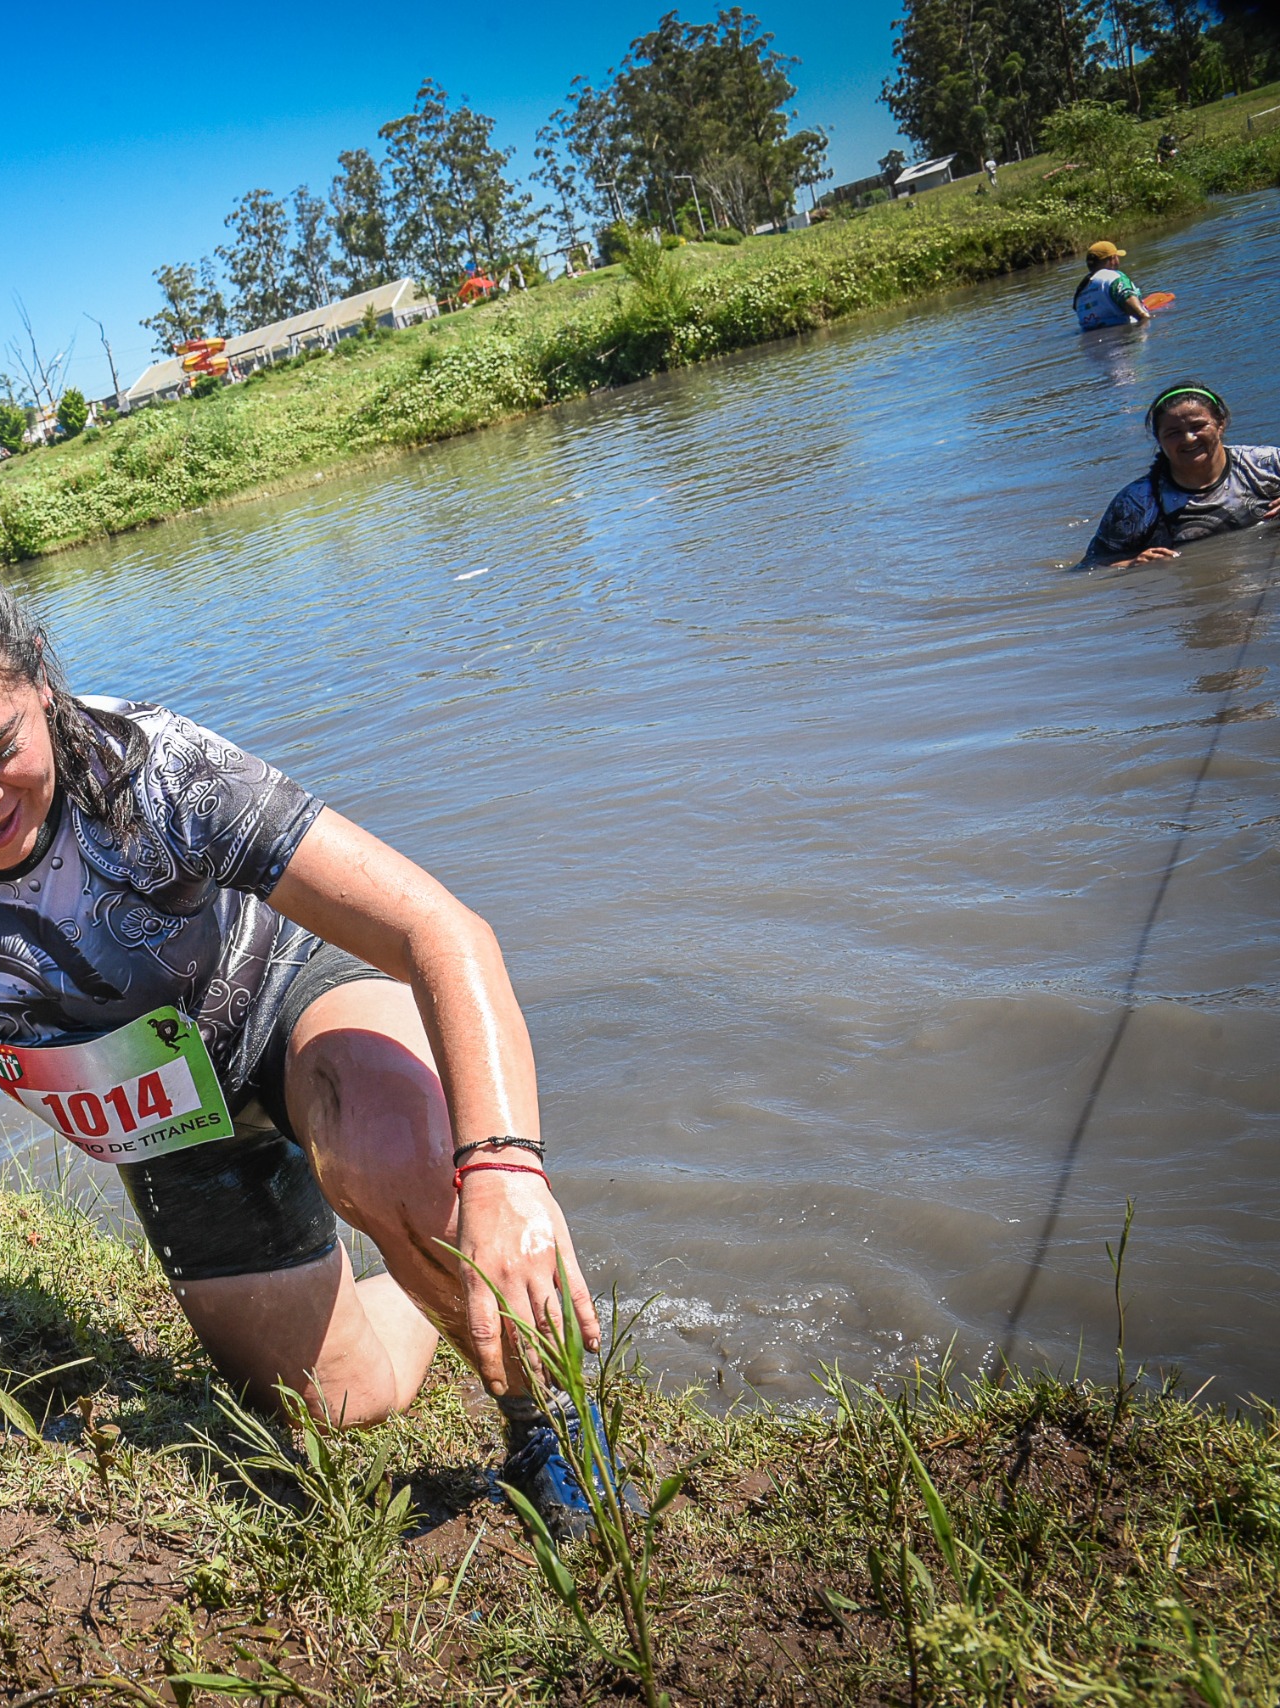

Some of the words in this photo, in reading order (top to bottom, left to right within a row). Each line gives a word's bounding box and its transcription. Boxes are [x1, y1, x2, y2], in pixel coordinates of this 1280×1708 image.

[41, 1071, 173, 1137] 1014
[108, 1141, 134, 1154] DE
[138, 1112, 221, 1147] TITANES
